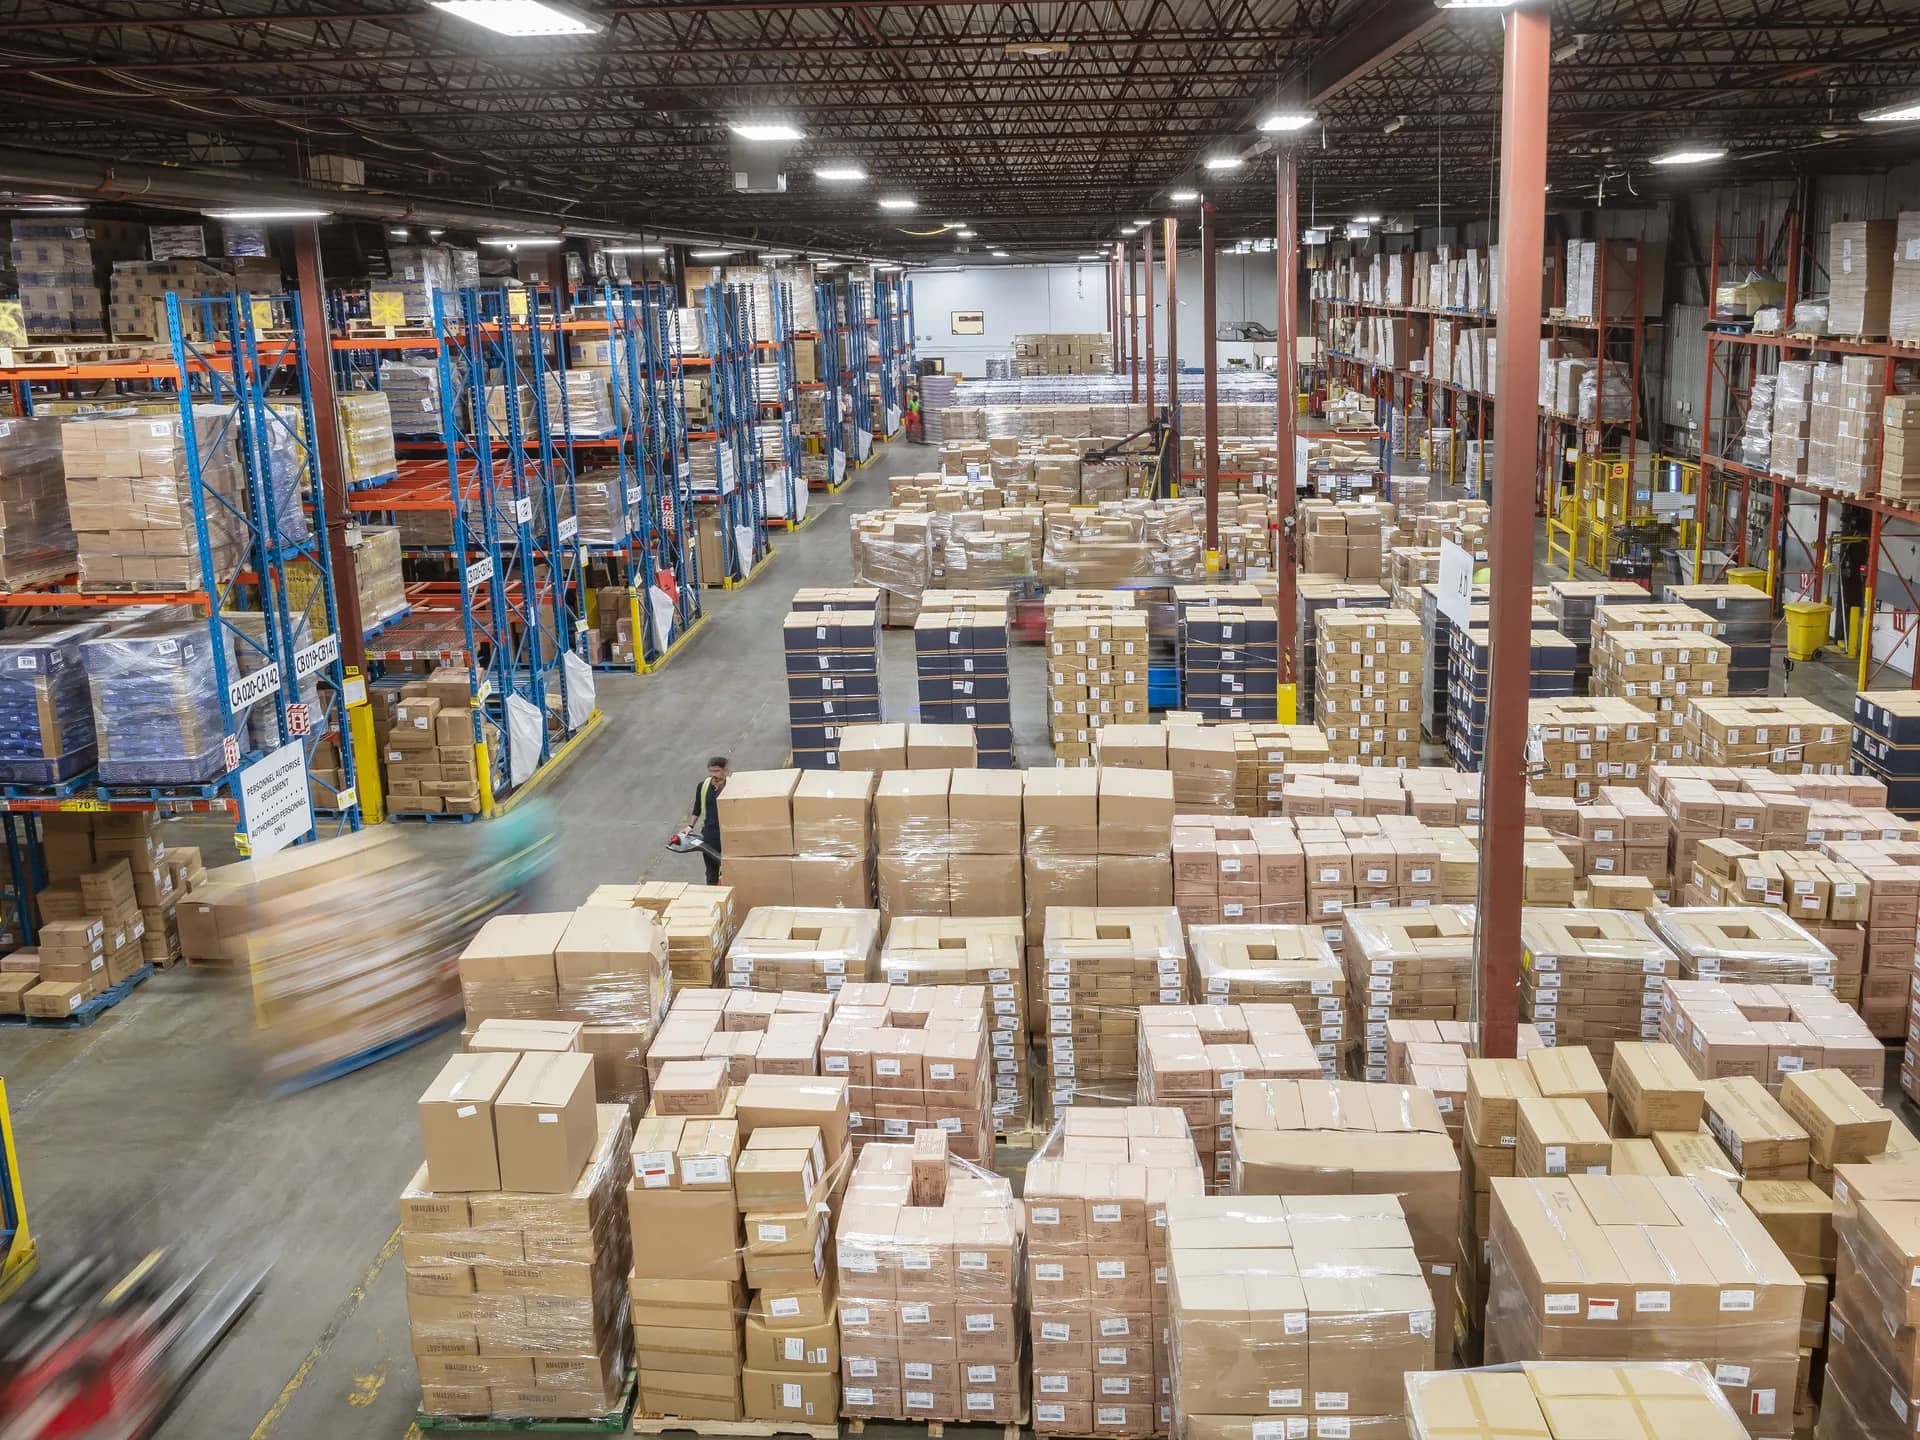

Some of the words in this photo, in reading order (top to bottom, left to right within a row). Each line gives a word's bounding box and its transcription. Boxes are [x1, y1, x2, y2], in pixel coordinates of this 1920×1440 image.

[296, 639, 336, 674] CB019-CB141
[231, 668, 279, 706] CA020-CA142
[246, 774, 276, 797] PERSONNEL
[275, 756, 302, 779] AUTORISÉ
[260, 778, 289, 802] SEULEMENT
[78, 801, 91, 809] 70
[251, 813, 281, 838] AUTHORIZED
[279, 797, 307, 819] PERSONNEL
[273, 823, 287, 836] ONLY
